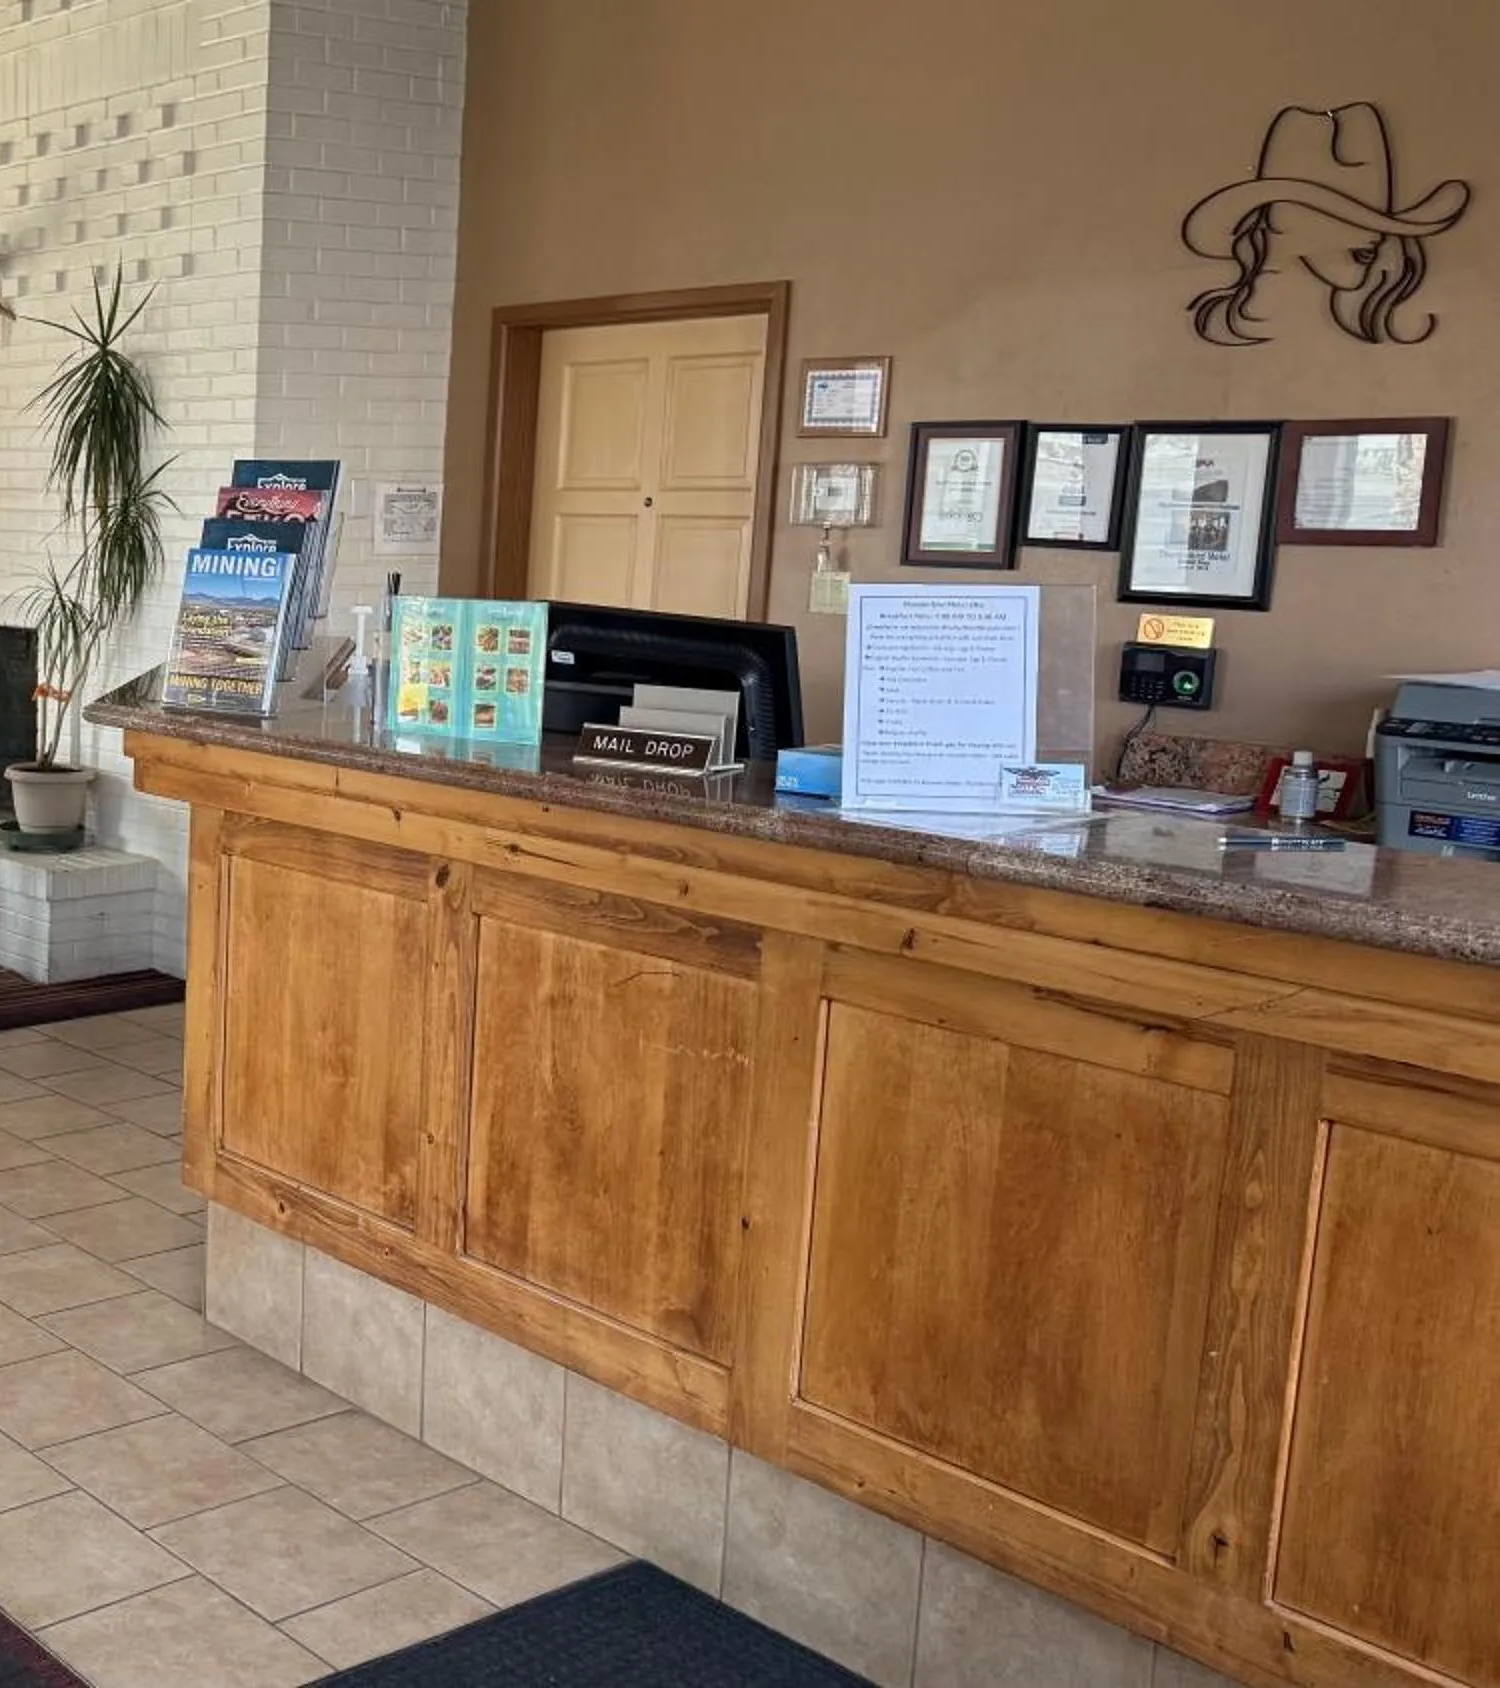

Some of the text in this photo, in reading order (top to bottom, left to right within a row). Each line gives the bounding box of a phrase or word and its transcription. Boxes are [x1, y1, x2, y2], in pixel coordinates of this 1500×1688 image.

[191, 554, 277, 577] MINING
[593, 735, 695, 759] MAIL DROP
